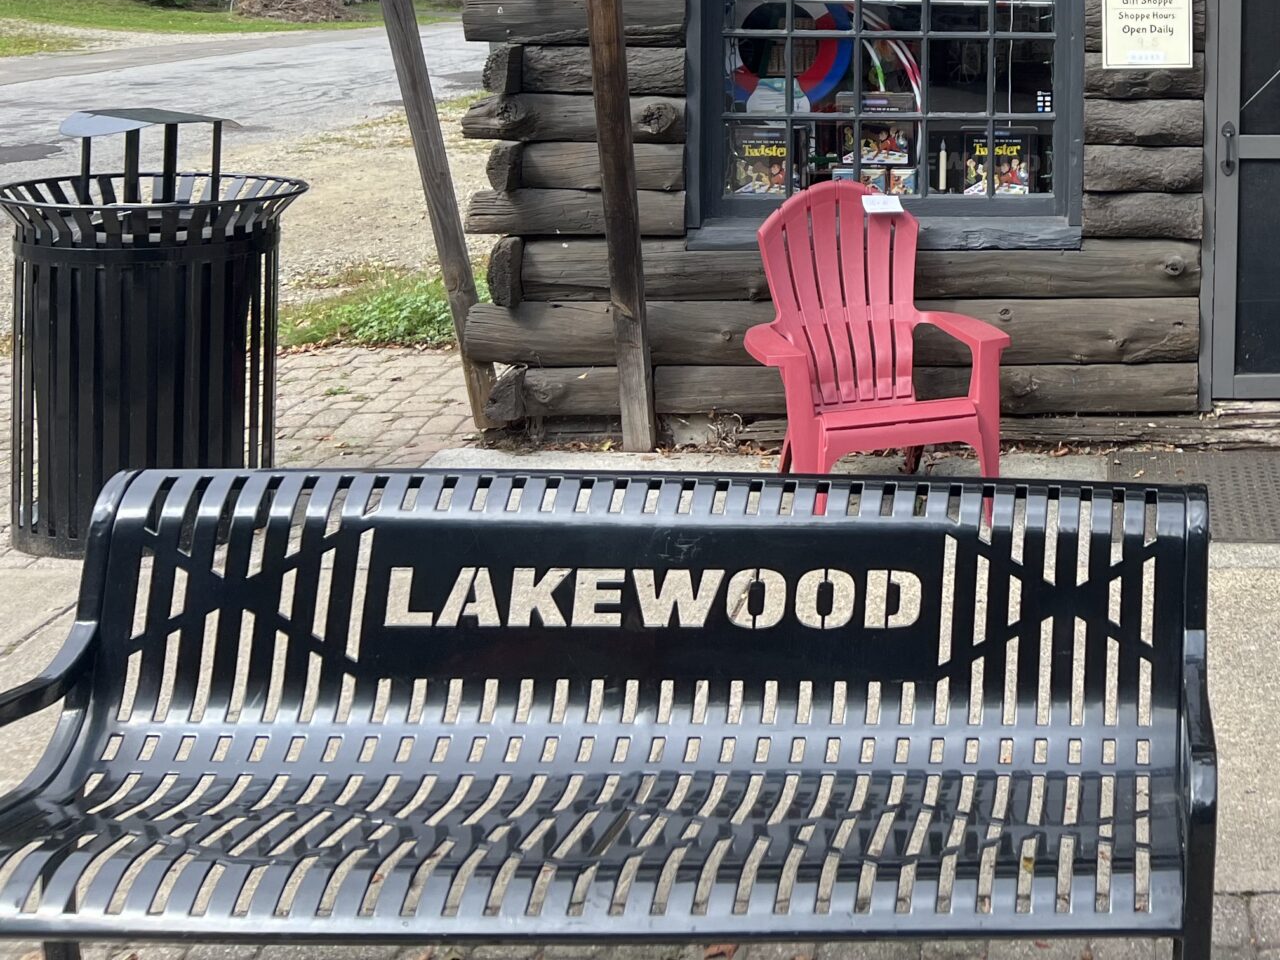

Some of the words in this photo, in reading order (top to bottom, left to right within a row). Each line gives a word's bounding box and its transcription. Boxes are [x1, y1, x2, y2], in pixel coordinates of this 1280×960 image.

[1118, 11, 1150, 21] Shoppe
[1122, 24, 1147, 37] Open
[1150, 24, 1174, 36] Daily
[973, 143, 1021, 157] Twster
[383, 566, 922, 630] LAKEWOOD
